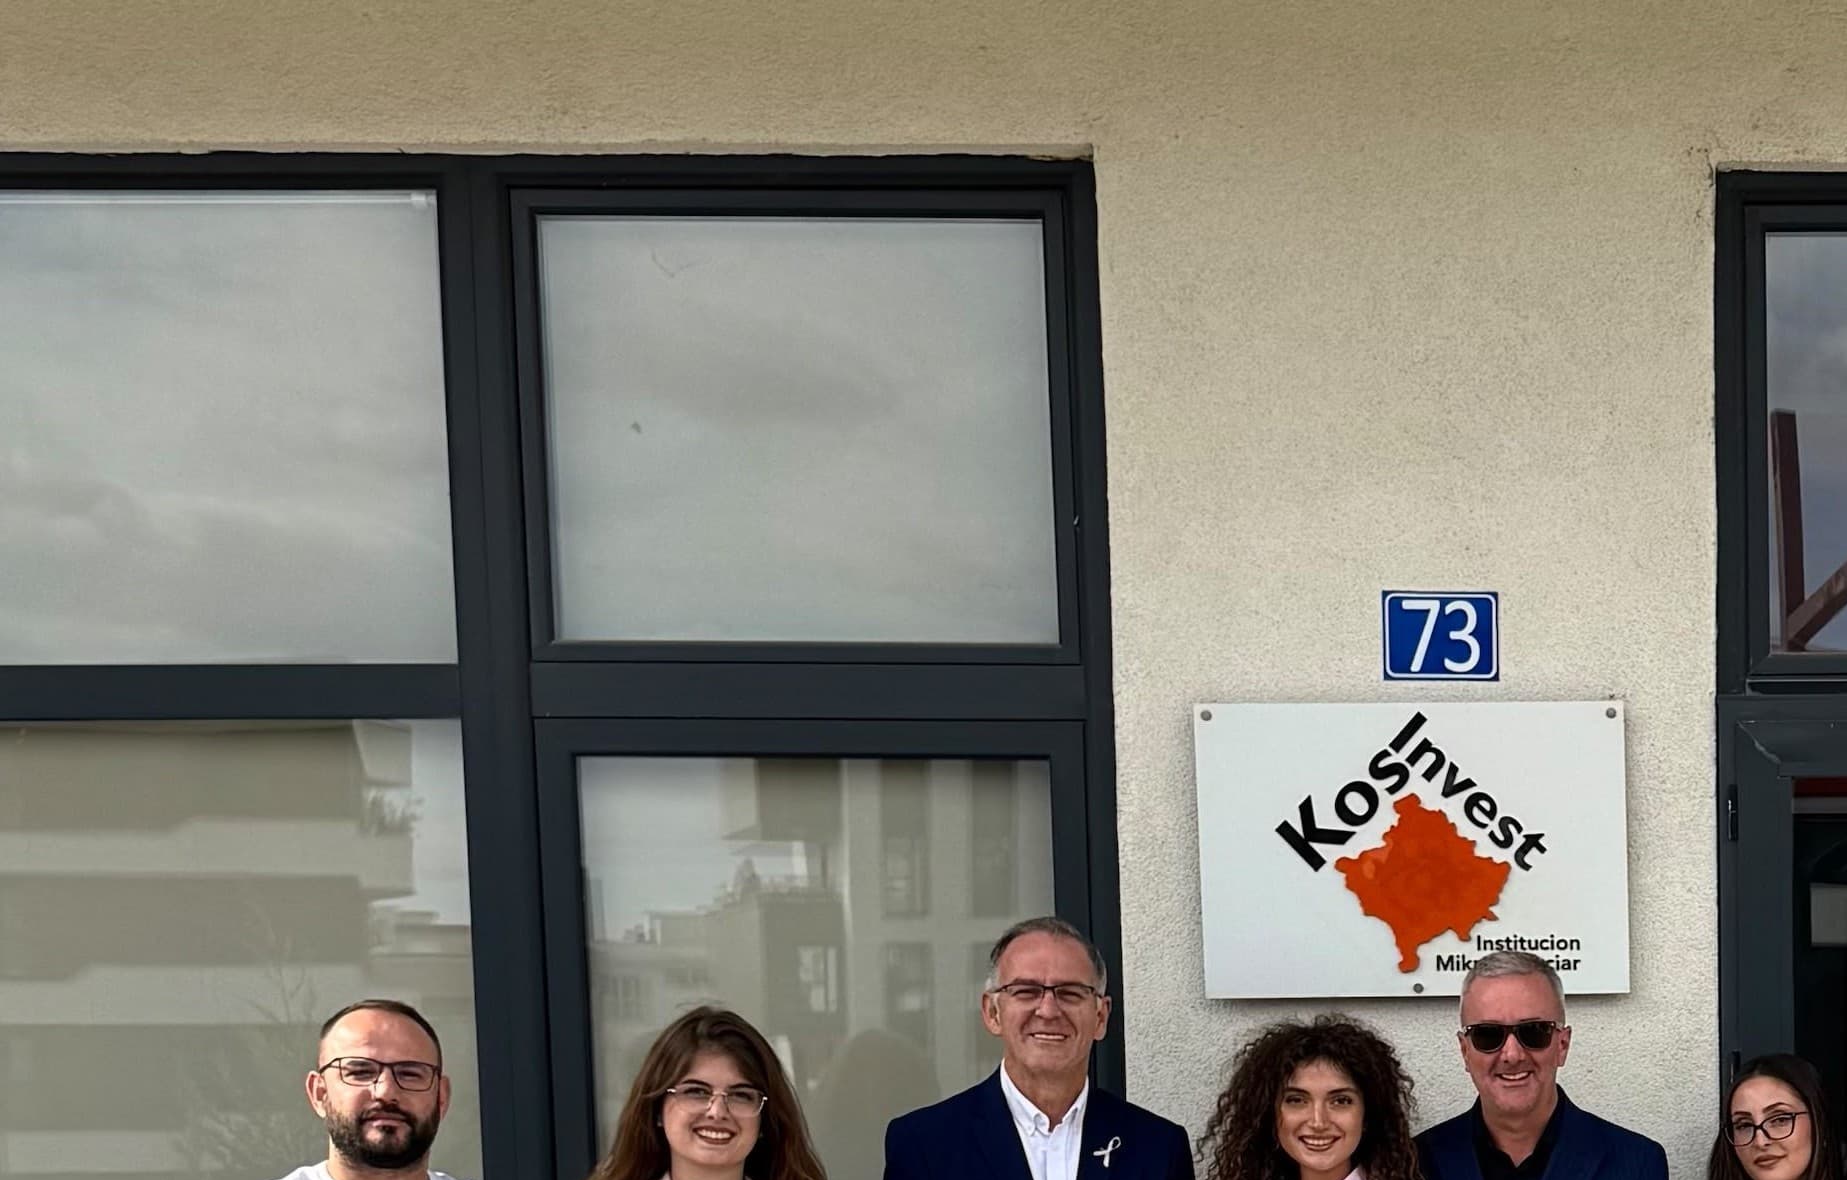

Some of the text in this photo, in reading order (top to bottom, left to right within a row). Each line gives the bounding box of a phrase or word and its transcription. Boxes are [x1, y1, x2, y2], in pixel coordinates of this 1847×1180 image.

[1401, 599, 1481, 673] 73
[1476, 934, 1581, 951] Institucion
[1436, 954, 1581, 971] Mikciar
